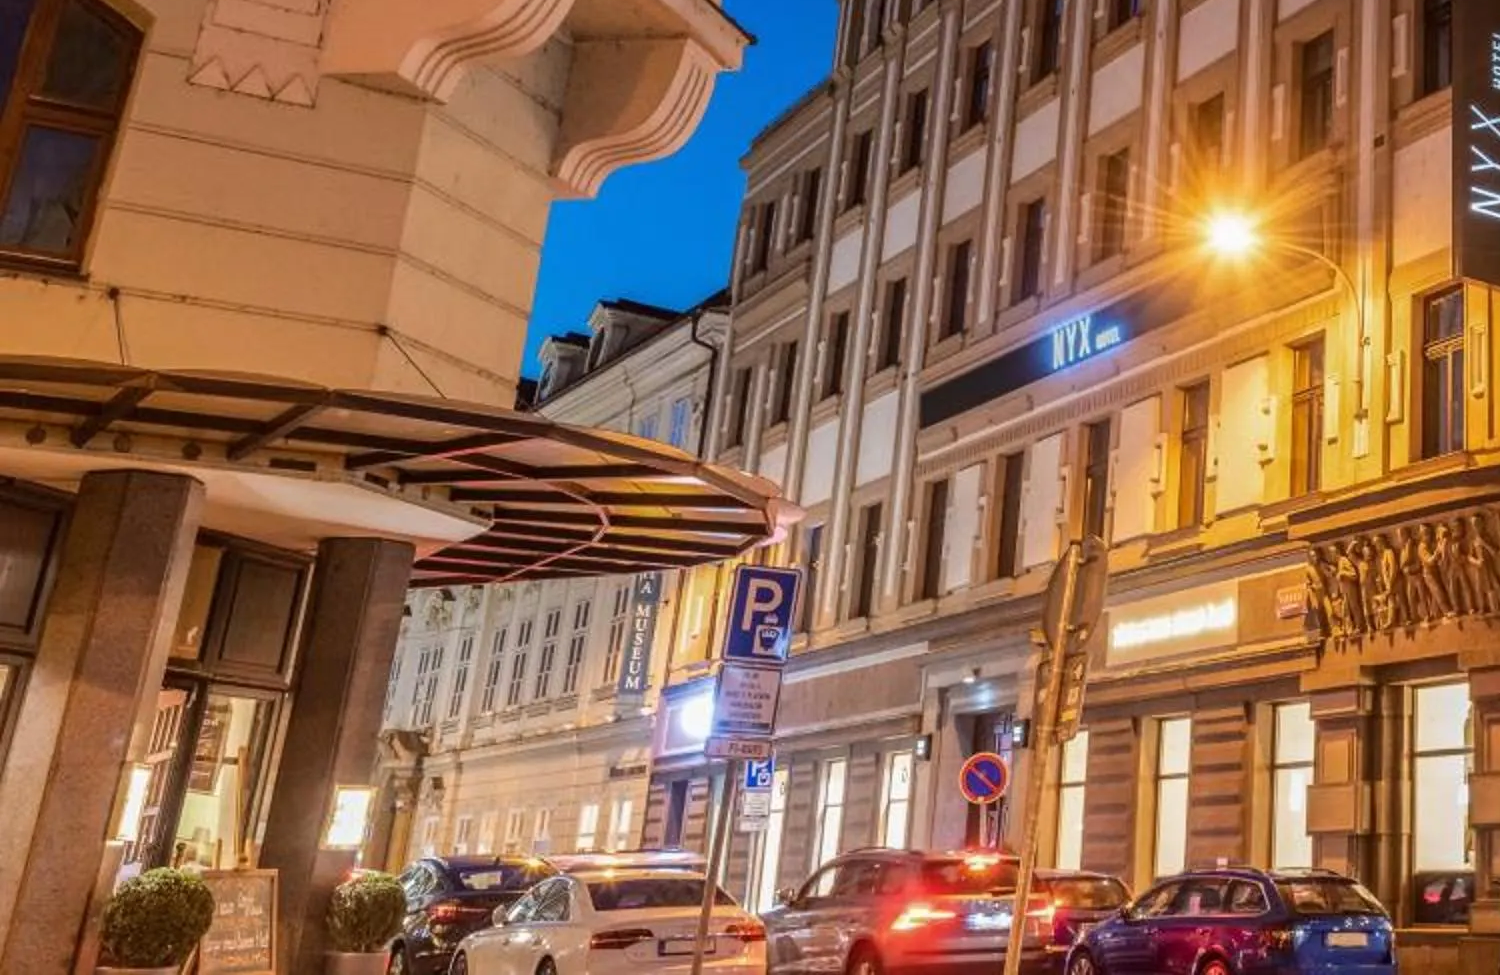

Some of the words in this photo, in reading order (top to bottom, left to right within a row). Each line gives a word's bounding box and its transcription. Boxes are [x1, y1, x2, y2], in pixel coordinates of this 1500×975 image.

[1053, 315, 1090, 370] NYX
[742, 578, 783, 631] P
[624, 604, 651, 690] MUSEUM
